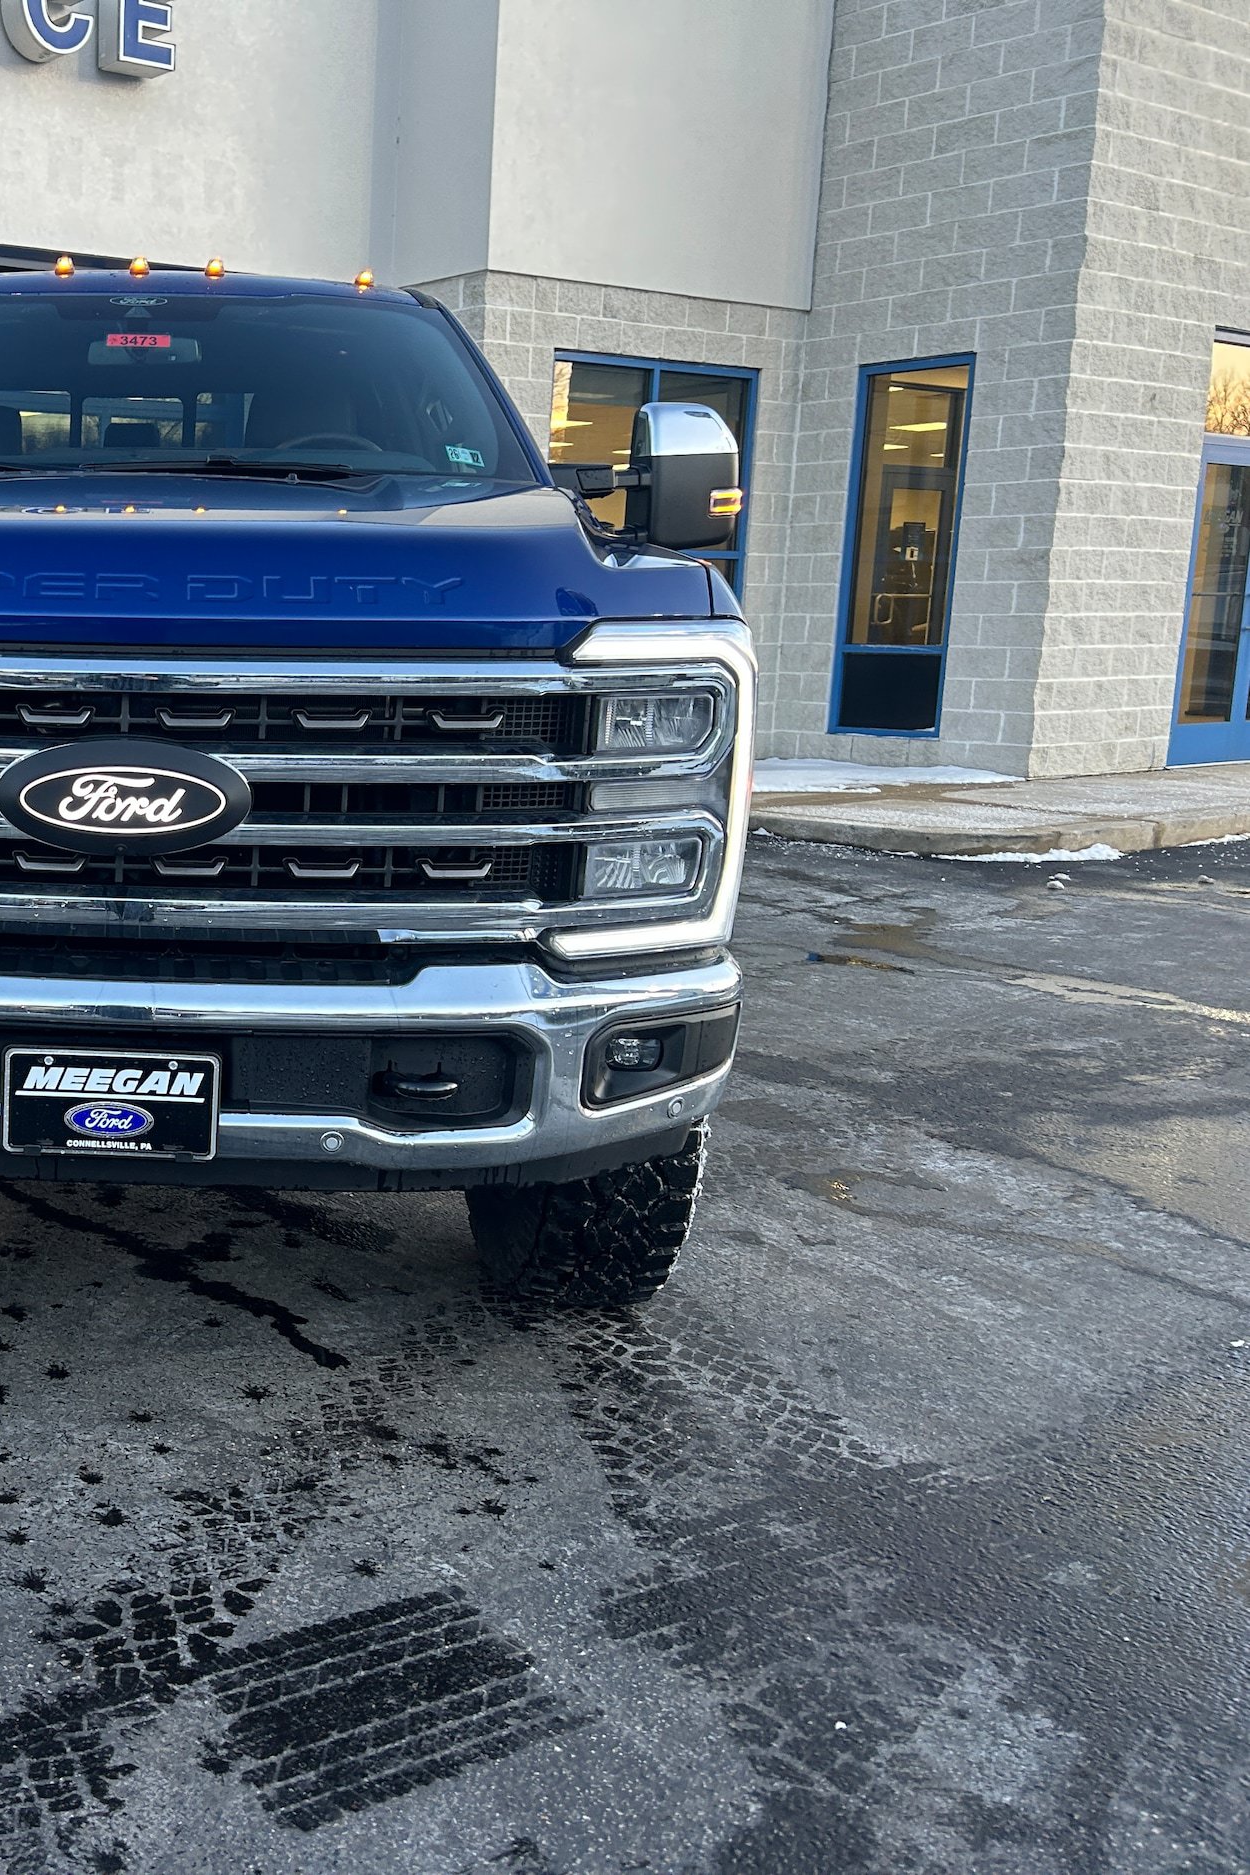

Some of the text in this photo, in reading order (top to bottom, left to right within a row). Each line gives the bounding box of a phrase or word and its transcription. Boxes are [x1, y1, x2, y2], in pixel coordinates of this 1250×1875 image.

[120, 336, 157, 346] 3473
[186, 575, 464, 604] DUTY
[58, 773, 186, 823] Ford
[22, 1066, 205, 1096] MEEGAN
[84, 1108, 133, 1130] Ford
[66, 1139, 153, 1150] CONNELLSVILLE, PA
